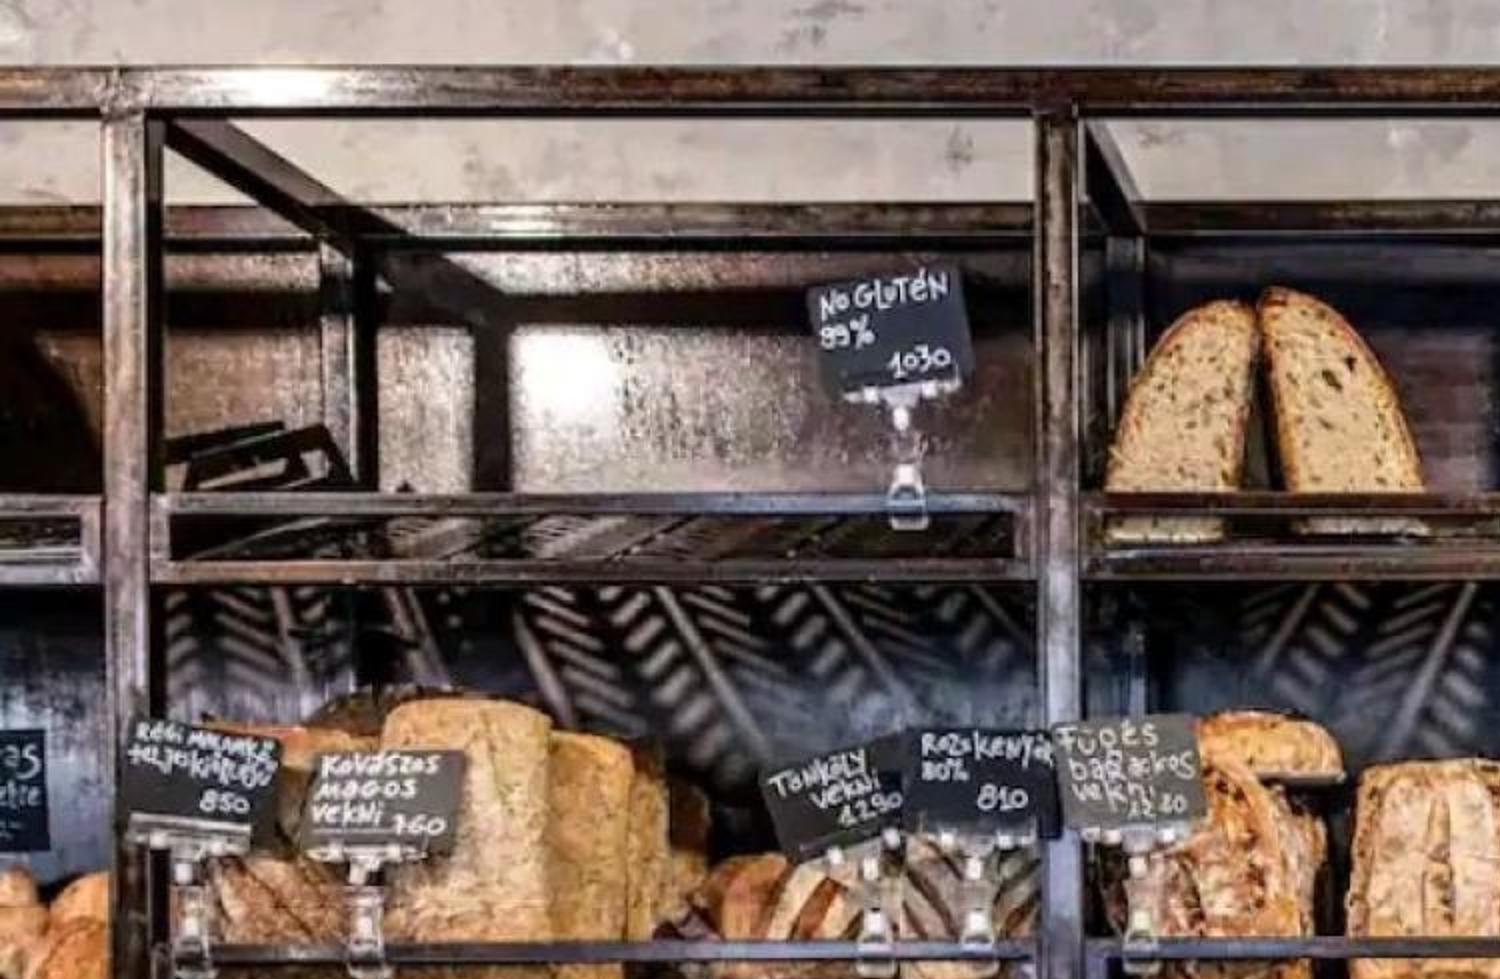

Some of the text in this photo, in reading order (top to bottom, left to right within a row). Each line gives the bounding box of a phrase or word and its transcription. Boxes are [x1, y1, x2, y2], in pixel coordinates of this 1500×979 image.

[887, 344, 950, 379] 1030
[200, 788, 250, 814] 850
[976, 783, 1029, 811] 810
